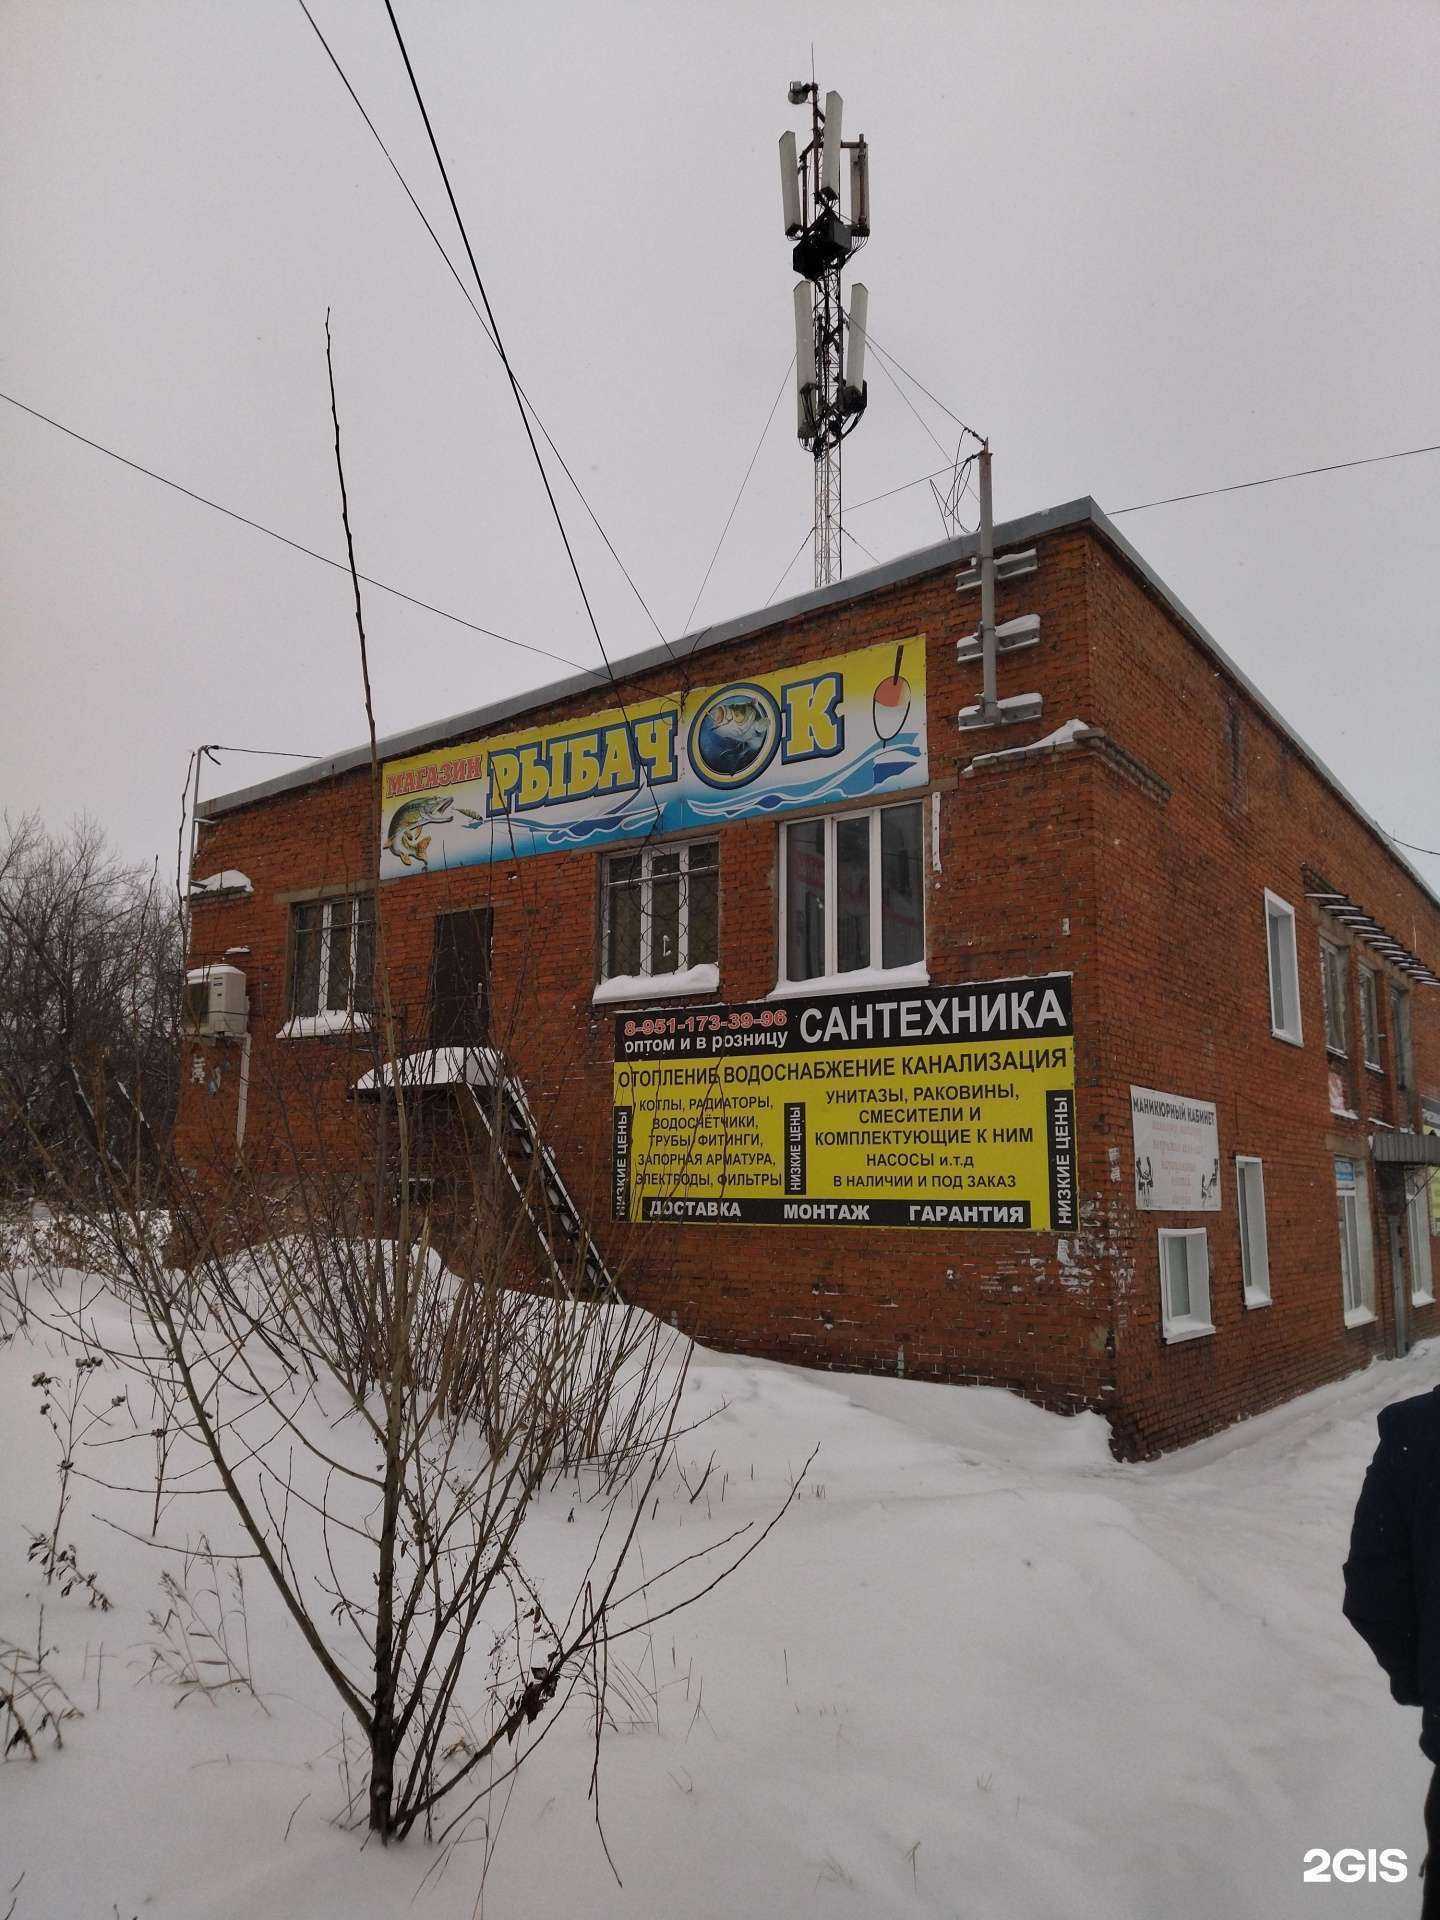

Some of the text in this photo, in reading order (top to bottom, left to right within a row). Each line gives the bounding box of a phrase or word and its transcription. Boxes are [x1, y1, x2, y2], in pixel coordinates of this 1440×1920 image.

[487, 673, 845, 817] РЫБАЧОК
[386, 754, 483, 799] МАГАЗИН
[624, 1009, 788, 1037] 8-951-173-39-96
[800, 989, 1067, 1044] САНТЕХНИКА
[625, 1030, 789, 1053] оптом и в розницу
[618, 1047, 1067, 1088] ОТОПЛЕНИЕ ВОДОСНАБЖЕНИЕ КАНАЛИЗАЦИЯ
[639, 1095, 773, 1112] КОТЛЫ, РАДИАТОРЫ,
[826, 1083, 1020, 1105] УНИТАЗЫ, РАКОВИНЫ,
[652, 1114, 759, 1131] ВОДОСЧЁТЧИКИ,
[859, 1106, 982, 1124] СМЕСИТЕЛИ И
[1133, 1097, 1216, 1126] МАНИКЮРНЫЙ КАБИНЕТ
[698, 1134, 763, 1149] ФИТИНГИ,
[815, 1127, 1034, 1147] КОМПЛЕКТУЮЩИЕ К НИМ
[638, 1153, 776, 1167] ЗАПОРНАЯ АРМАТУРА,
[790, 1107, 802, 1191] НИЗКИЕ ЦЕНЫ
[866, 1153, 935, 1167] НАСОСЫ
[616, 1111, 629, 1216] НИЗКИЕ ЦЕНЫ
[1054, 1097, 1072, 1225] НИЗКИЕ ЦЕНЫ
[636, 1173, 782, 1187] ЭЛЕКТРОДЫ, ФИЛЬТРЫ
[833, 1175, 1017, 1190] В НАЛИЧИИ И ПОД ЗАКАЗ
[649, 1201, 1024, 1223] ДОСТАВКА МОНТАЖ ГАРАНТИЯ
